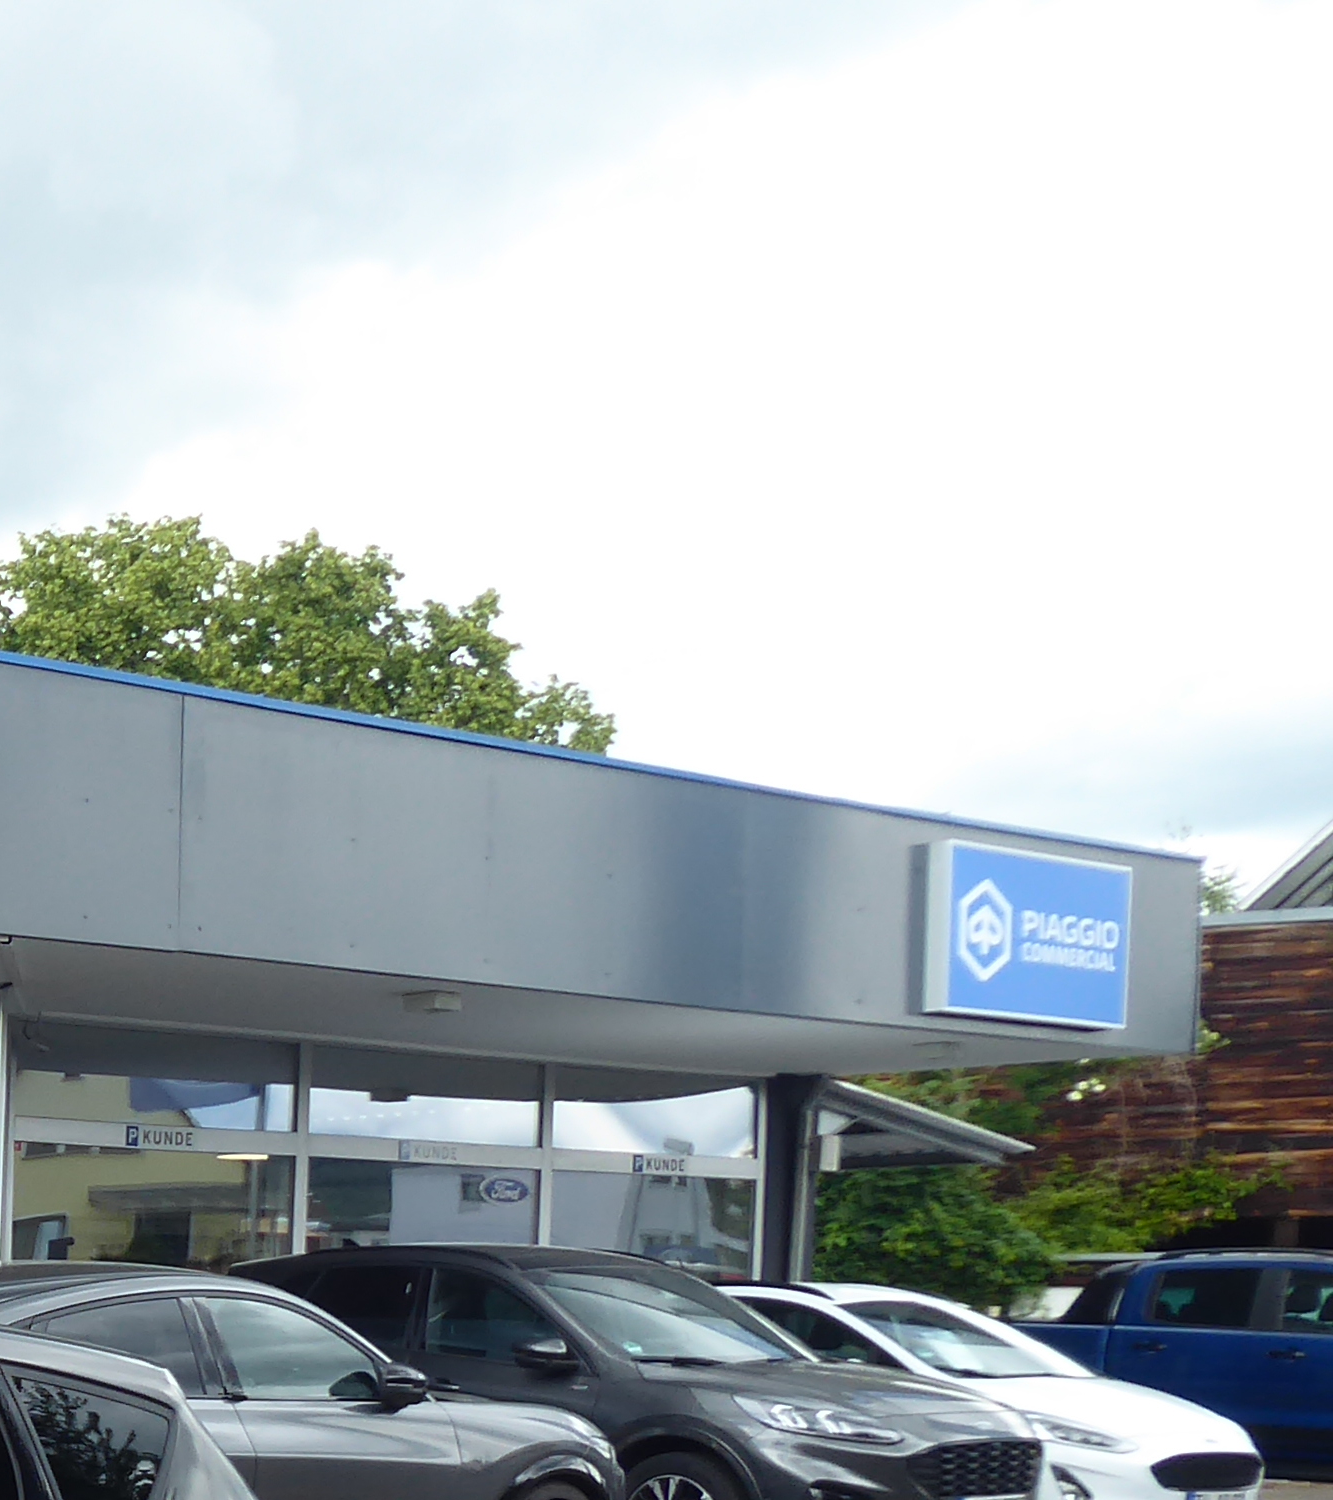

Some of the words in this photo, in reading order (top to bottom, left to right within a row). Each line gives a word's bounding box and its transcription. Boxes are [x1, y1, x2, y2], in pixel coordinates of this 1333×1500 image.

[1021, 910, 1120, 949] PIAGGIO
[1020, 942, 1116, 972] COMMERCIAL
[142, 1129, 193, 1146] KUNDE
[645, 1158, 685, 1171] KUNDE
